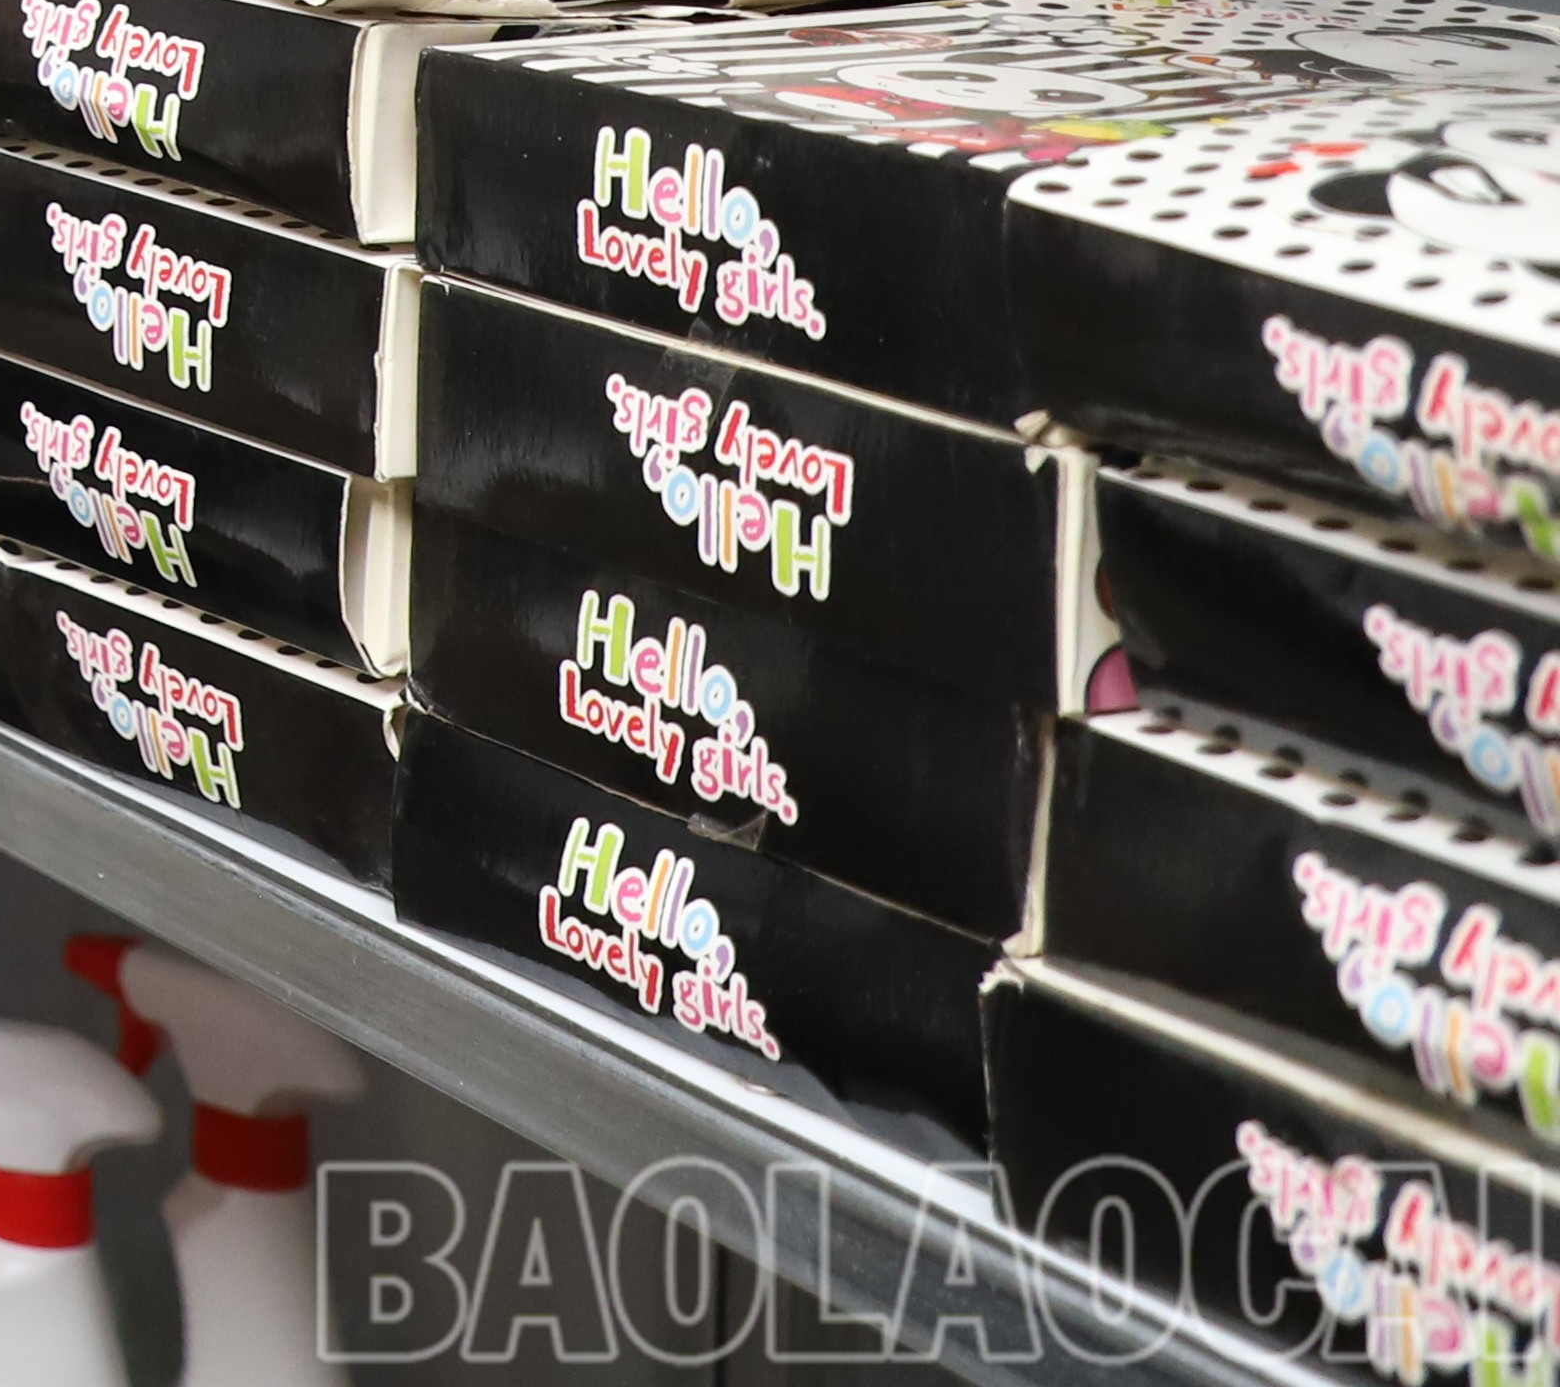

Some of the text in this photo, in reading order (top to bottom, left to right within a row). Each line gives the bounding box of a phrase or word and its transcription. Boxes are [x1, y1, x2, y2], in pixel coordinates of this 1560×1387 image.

[37, 49, 182, 163] Hello,
[101, 3, 206, 100] Lovely
[594, 126, 778, 258] Hello,
[45, 202, 231, 327] Lovely girls.
[73, 263, 214, 392] Hello,
[578, 199, 826, 339] Lovely girls.
[1262, 314, 1412, 425] girls.
[21, 401, 196, 530] Lovely girls.
[606, 373, 854, 524] Lovely girls.
[48, 462, 198, 587] Hello,
[644, 445, 831, 600] Hello,
[57, 610, 244, 751] Lovely girls.
[577, 589, 755, 744] Hello,
[1363, 602, 1518, 714] girls.
[92, 674, 242, 809] Hello,
[559, 659, 797, 825] Lovely girls.
[560, 818, 735, 976] Hello,
[1292, 851, 1444, 964] girls.
[538, 886, 782, 1059] Lovely girls.
